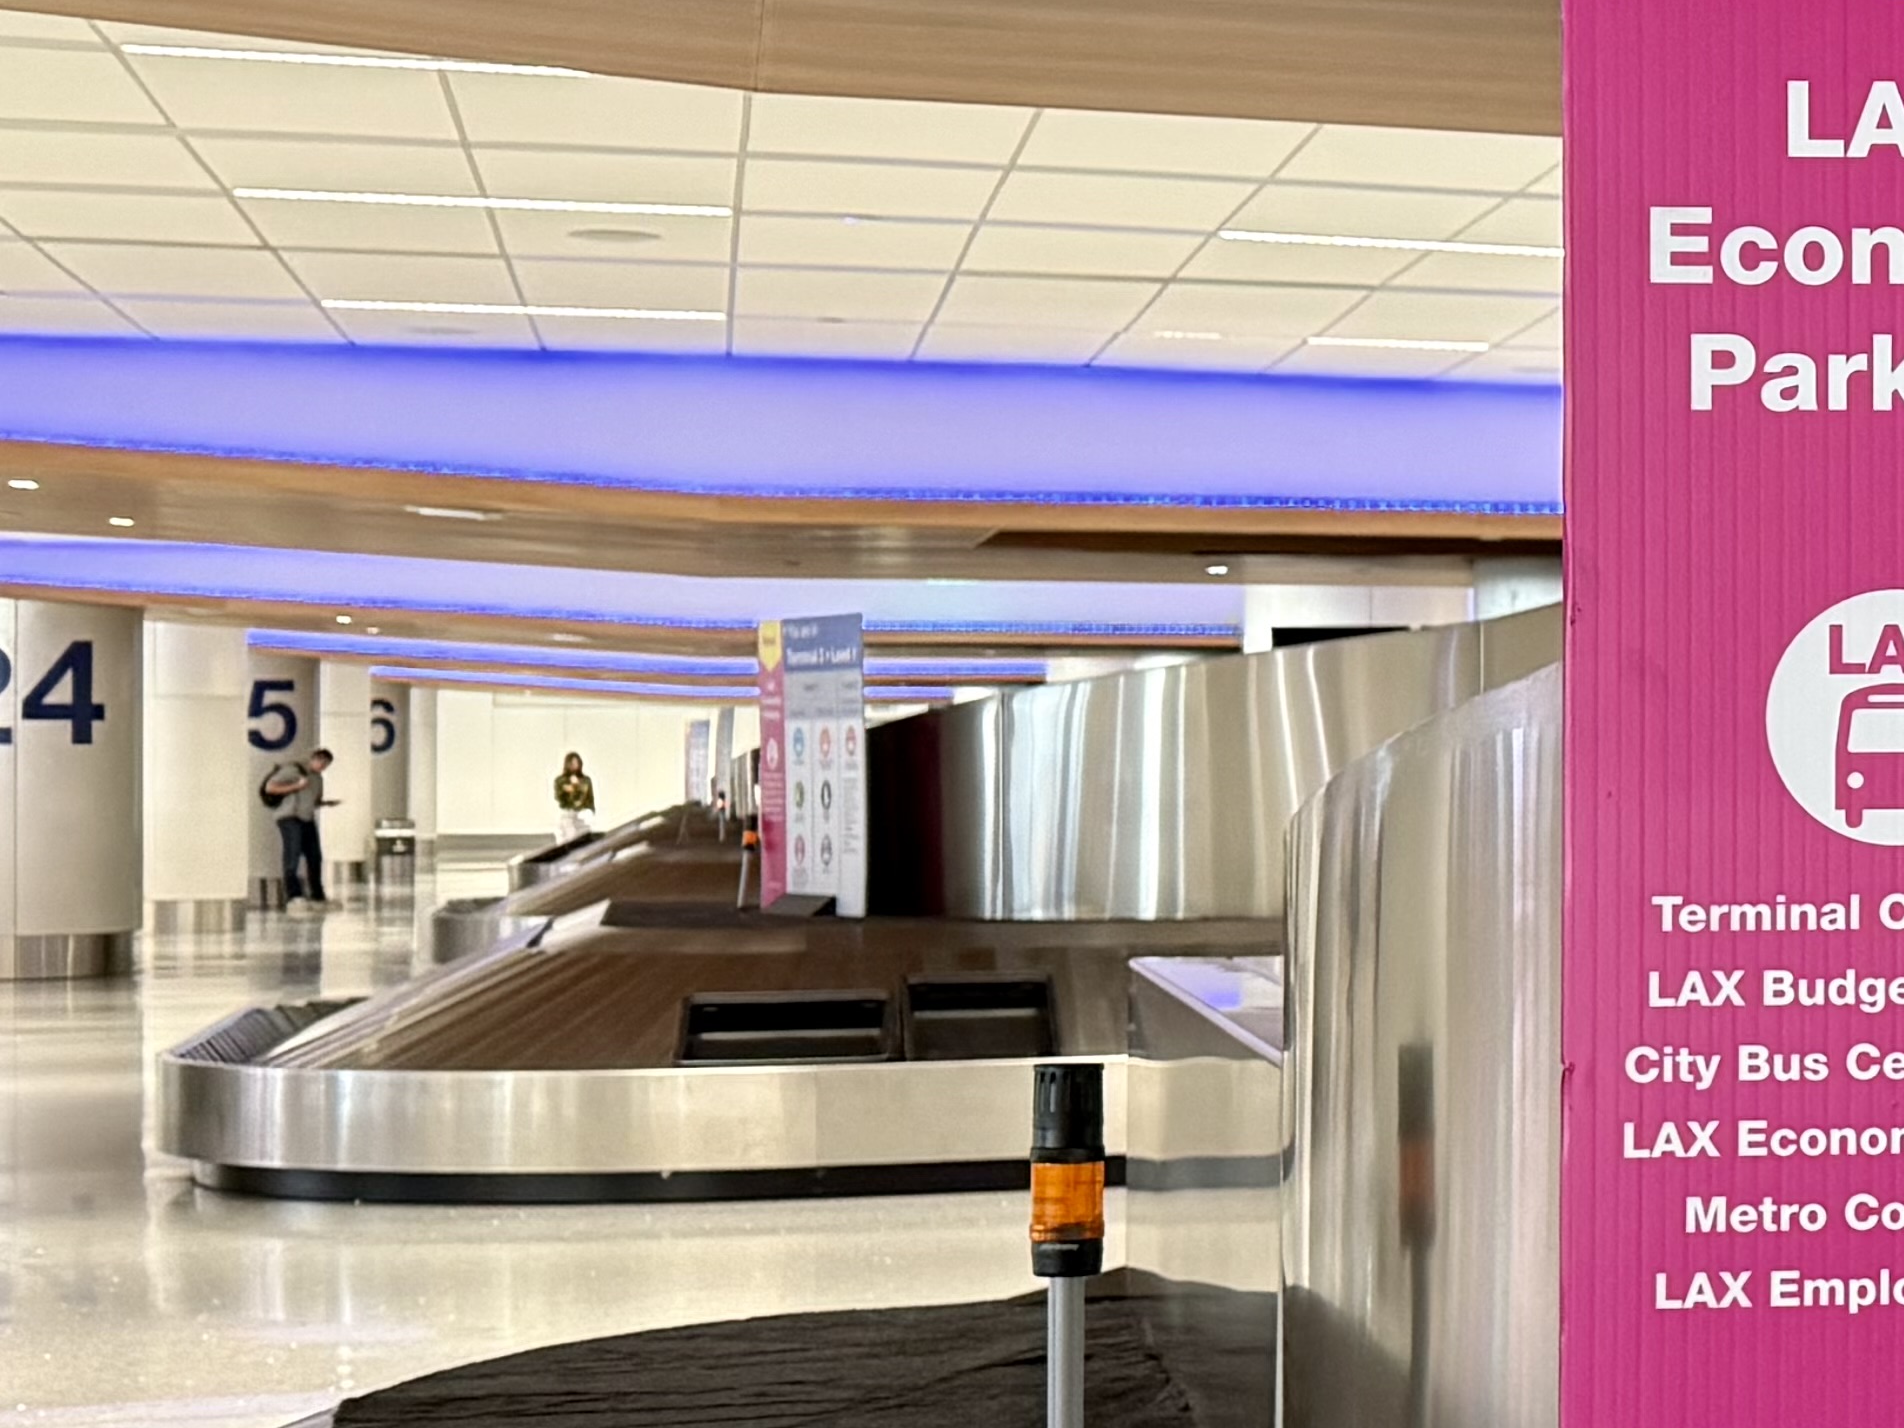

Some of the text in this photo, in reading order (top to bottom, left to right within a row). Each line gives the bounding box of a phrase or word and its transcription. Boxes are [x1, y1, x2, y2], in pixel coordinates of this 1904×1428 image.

[0, 639, 106, 745] 4
[1652, 894, 1861, 934] Terminal
[1649, 970, 1747, 1009] LAX
[1625, 1046, 1722, 1090] City
[1739, 1045, 1830, 1083] Bus
[1624, 1121, 1722, 1160] LAX
[1686, 1196, 1828, 1235] Metro
[1656, 1271, 1754, 1311] LAX
